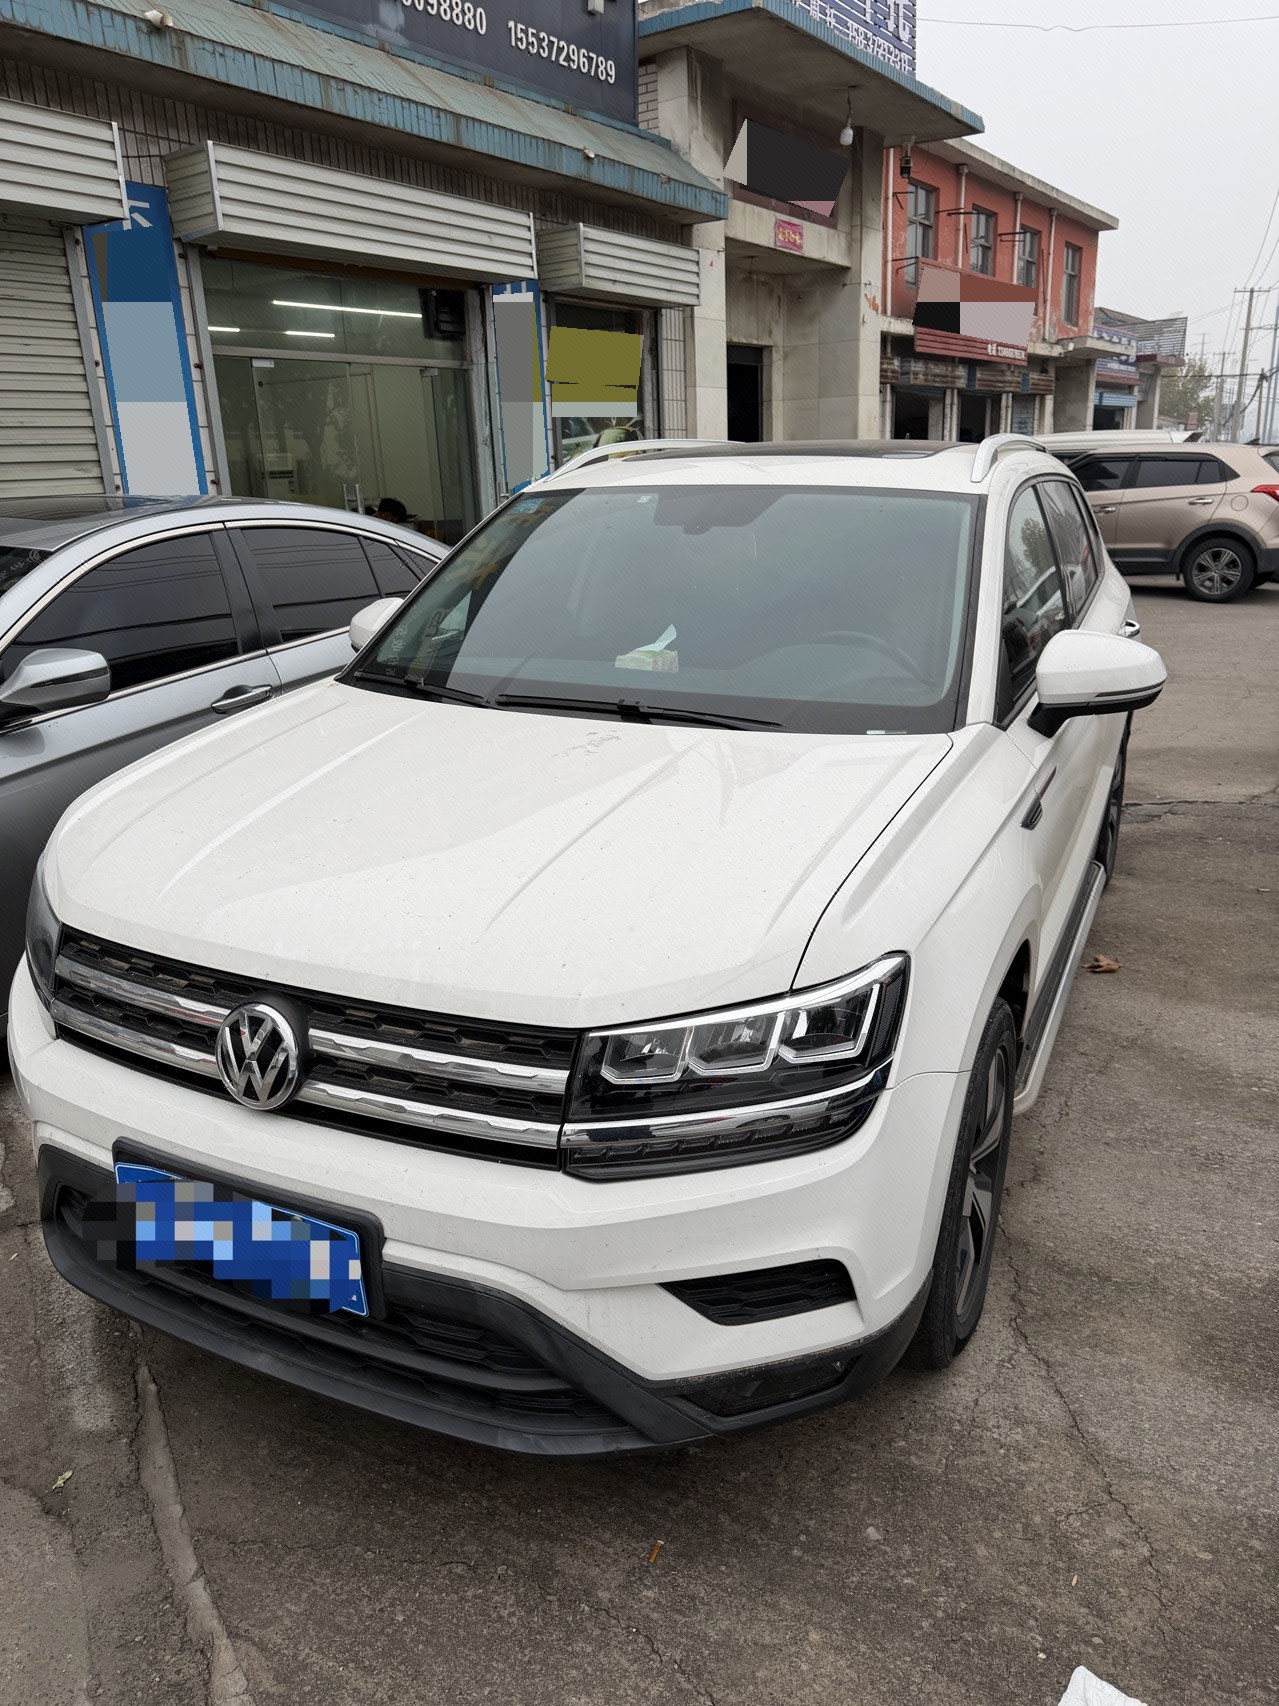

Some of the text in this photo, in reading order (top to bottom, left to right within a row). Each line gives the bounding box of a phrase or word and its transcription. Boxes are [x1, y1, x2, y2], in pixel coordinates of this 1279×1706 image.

[402, 0, 616, 84] 98880 15537296789
[216, 1003, 298, 1110] VW
